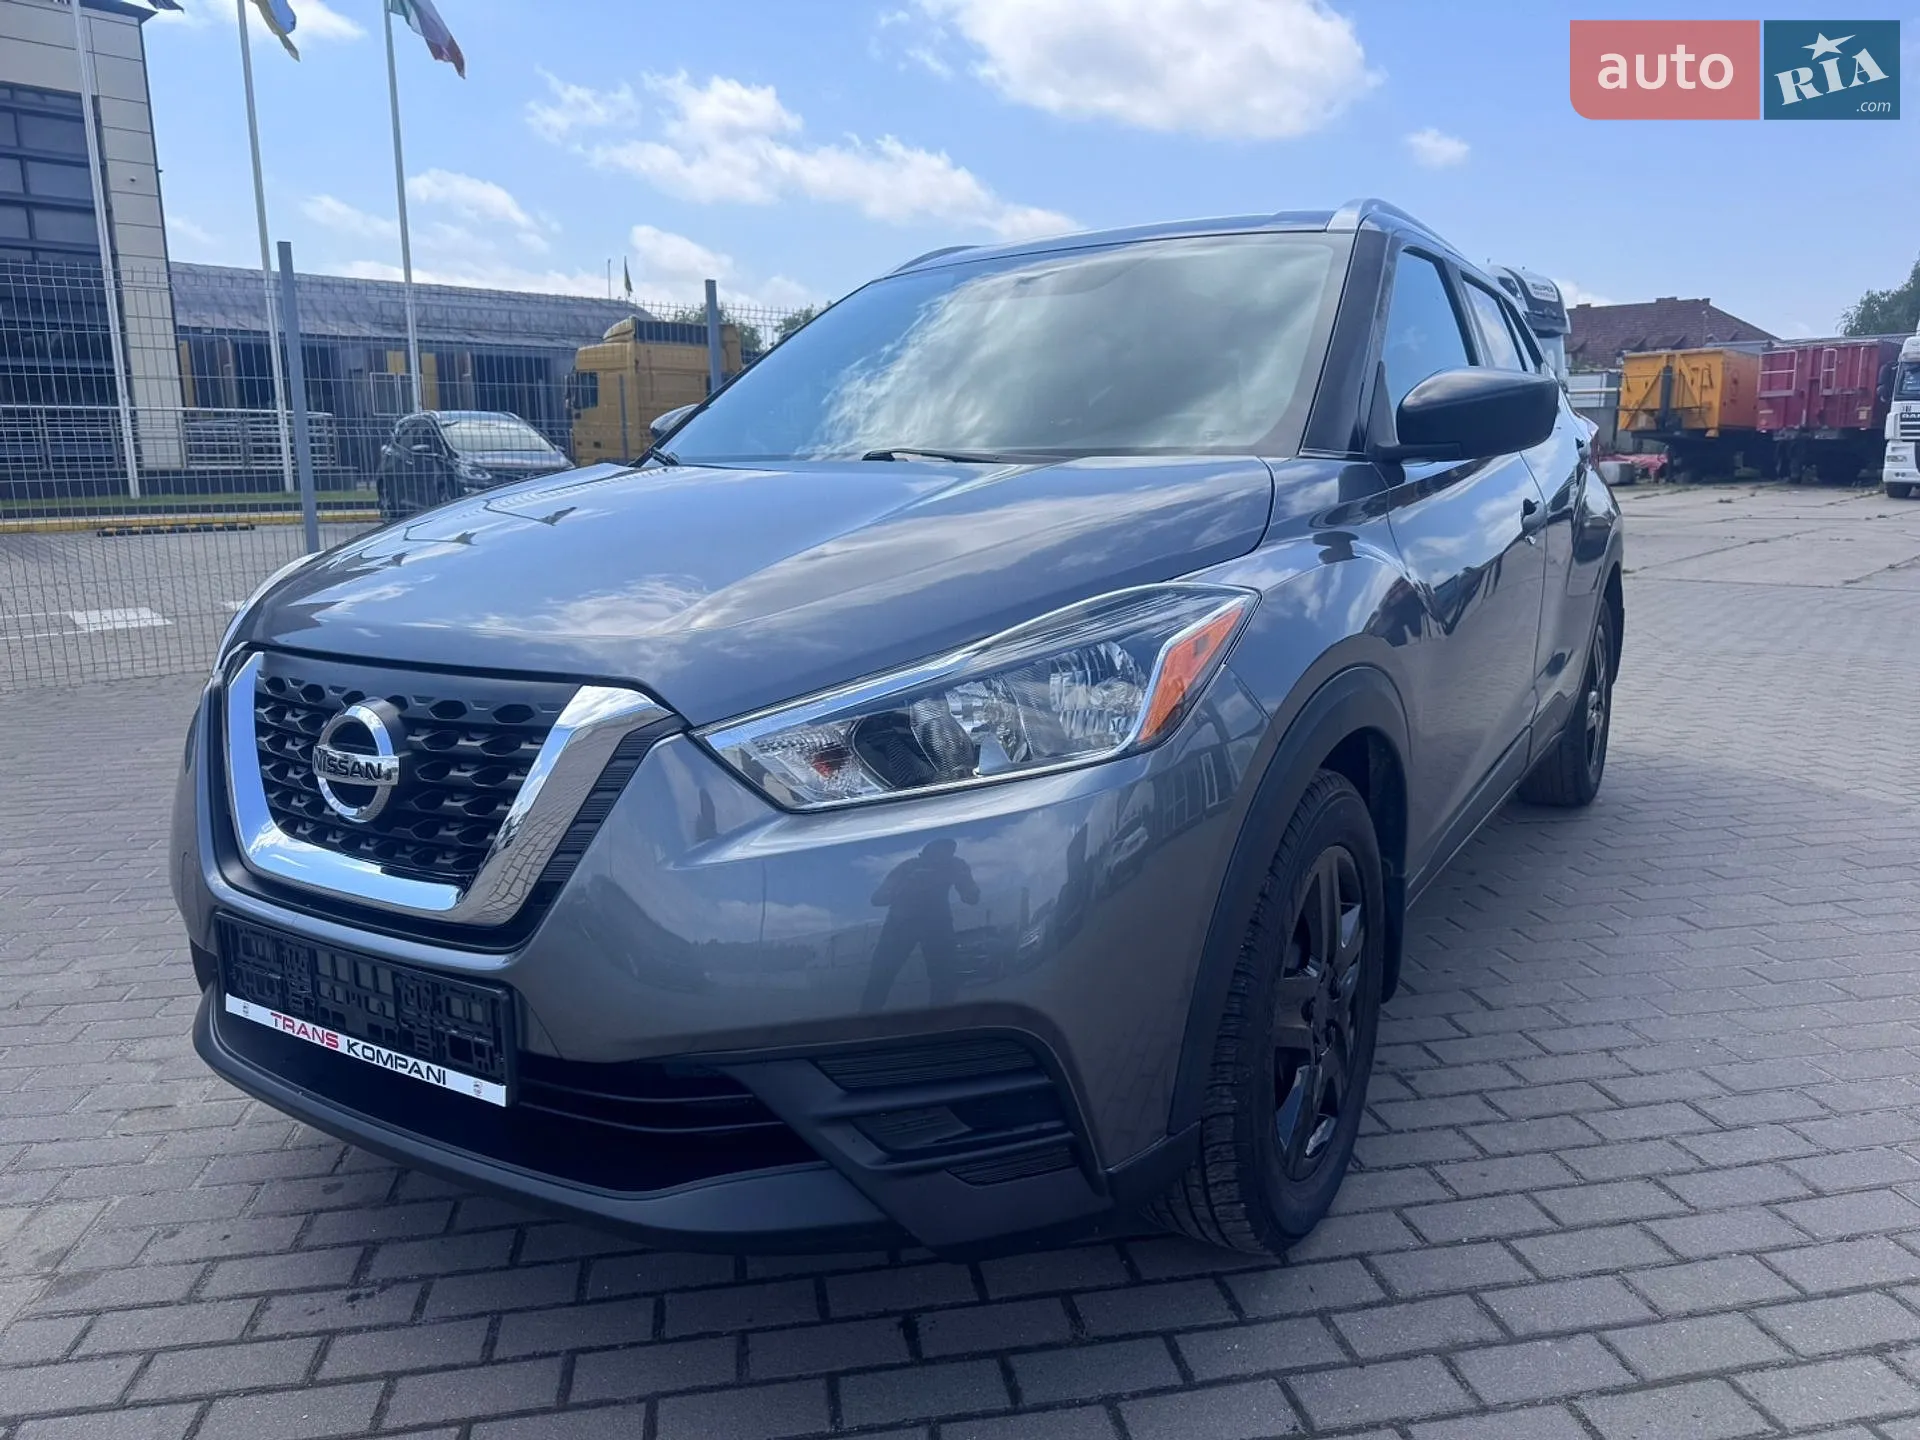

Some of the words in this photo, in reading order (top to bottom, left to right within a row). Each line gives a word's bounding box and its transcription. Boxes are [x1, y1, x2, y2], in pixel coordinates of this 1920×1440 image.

[313, 752, 383, 781] NISSAN
[270, 1012, 339, 1049] TRANS
[346, 1039, 447, 1086] KOMPANI
